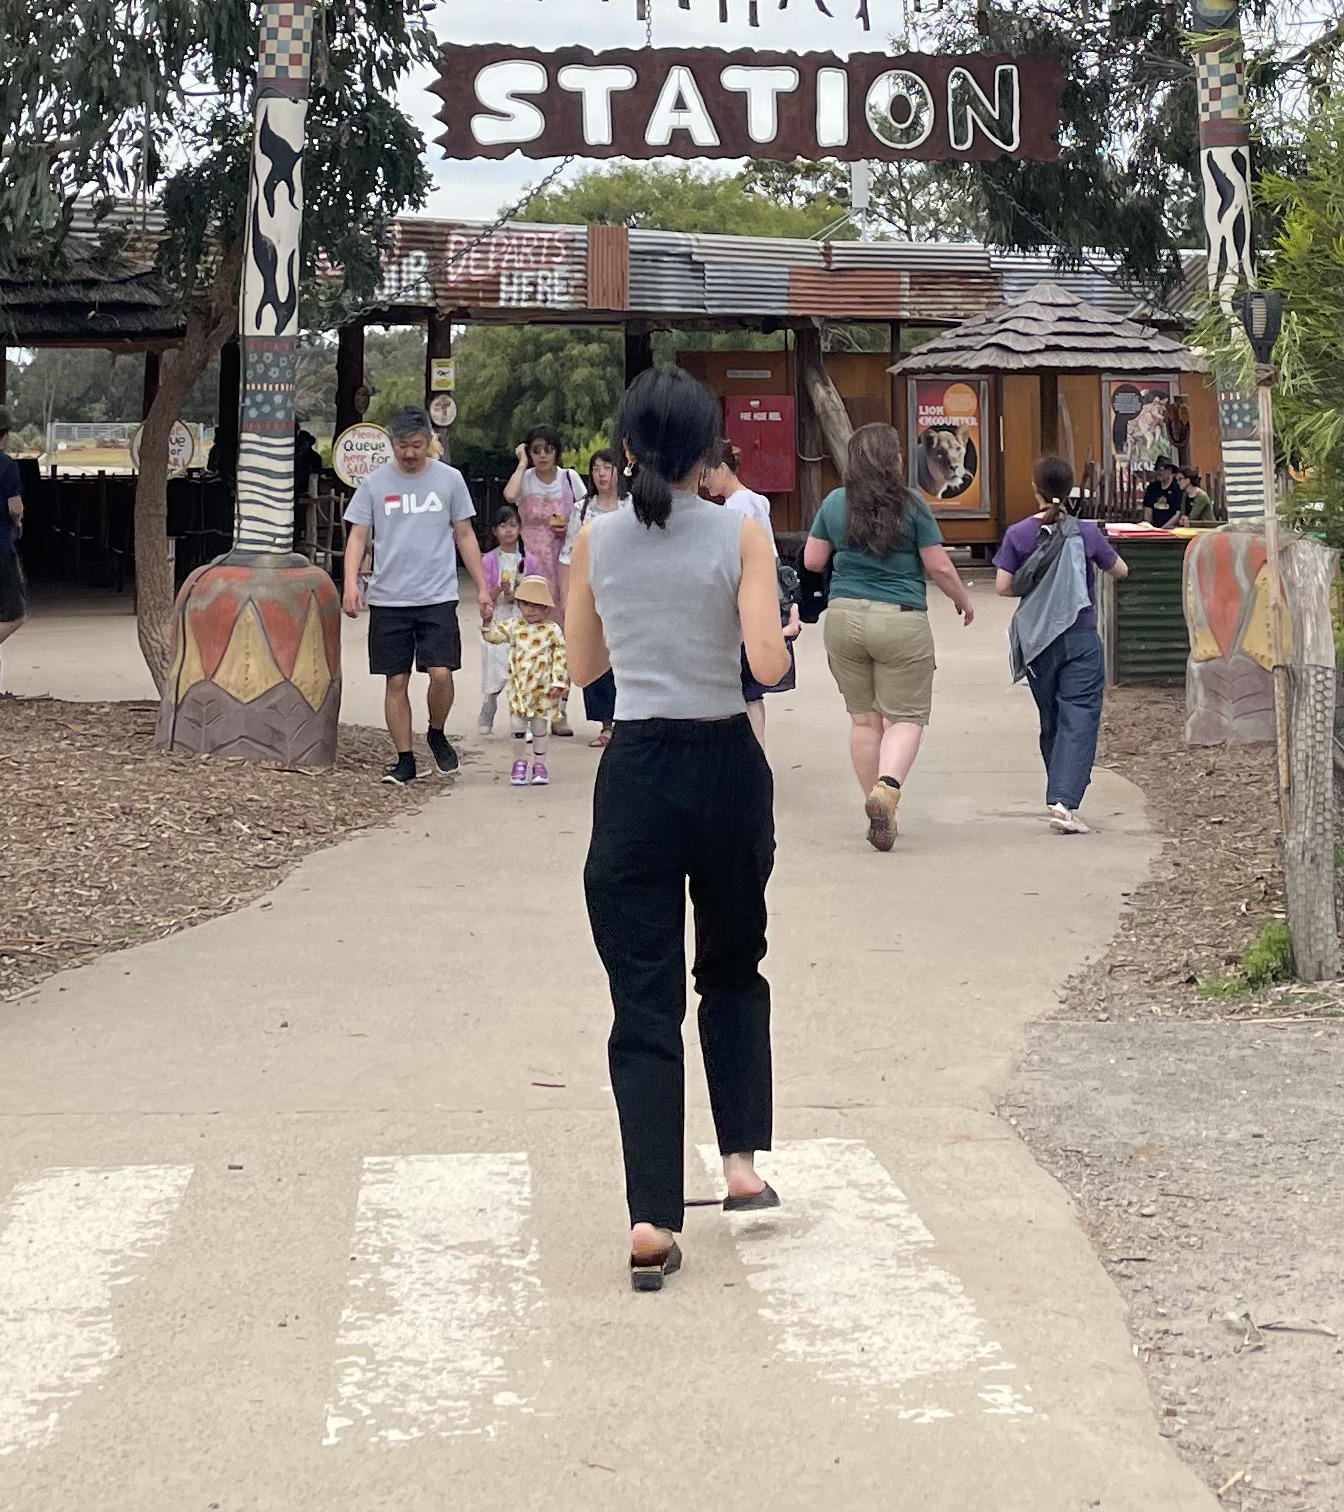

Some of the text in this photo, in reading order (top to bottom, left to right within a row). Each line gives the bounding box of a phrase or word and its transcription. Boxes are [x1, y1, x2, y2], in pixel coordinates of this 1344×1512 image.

[470, 59, 1021, 152] STATION
[499, 269, 574, 309] HERE
[918, 405, 945, 416] LION
[343, 439, 386, 452] Queue
[370, 452, 390, 465] for
[383, 491, 443, 516] FILA
